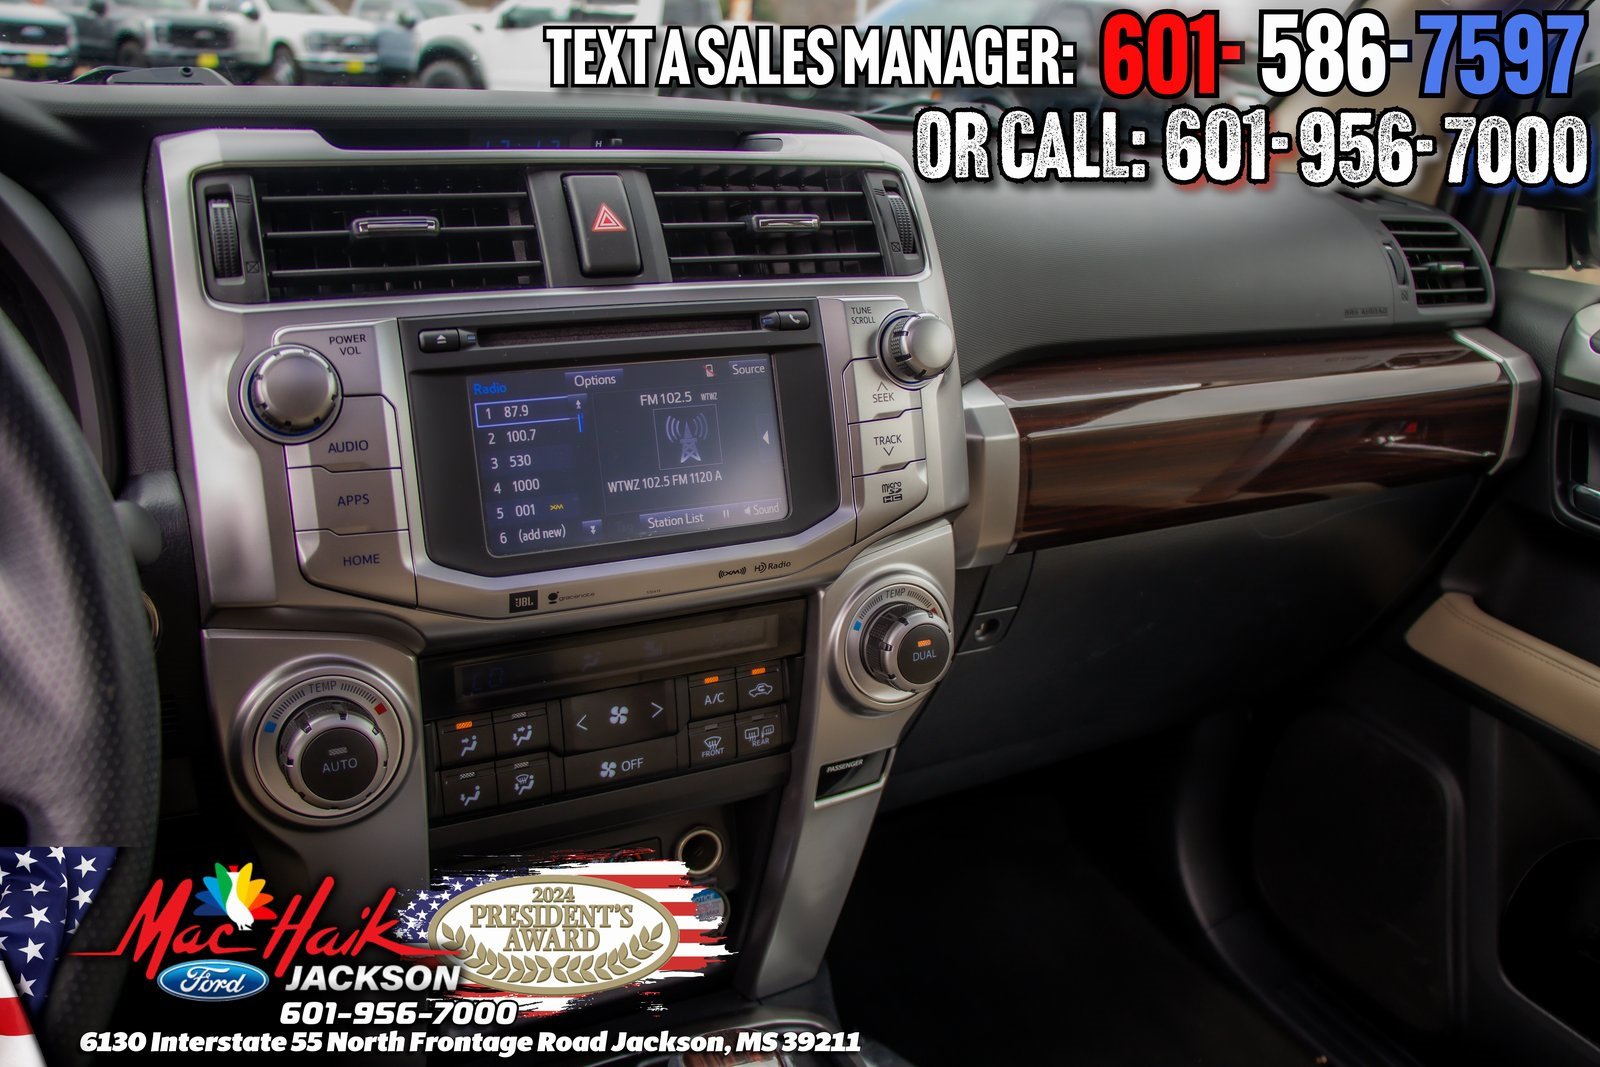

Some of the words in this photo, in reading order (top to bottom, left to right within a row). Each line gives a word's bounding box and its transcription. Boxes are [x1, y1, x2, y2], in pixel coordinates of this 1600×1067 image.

[851, 306, 872, 315] TUNE
[851, 316, 876, 325] SCROLL
[329, 334, 367, 345] POWER
[339, 346, 361, 356] VOL
[732, 363, 766, 376] Source
[574, 374, 616, 387] Options
[473, 383, 507, 394] Radio
[640, 393, 658, 406] FM
[660, 391, 693, 405] 102.5
[701, 391, 718, 401] WTWZ
[872, 392, 895, 404] SEEK
[485, 408, 492, 420] 1
[504, 405, 529, 418] 87.9
[488, 432, 496, 445] 2
[506, 429, 537, 443] 100.7
[874, 434, 902, 446] TRACK
[328, 439, 369, 454] AUDIO
[490, 457, 499, 469] 3
[509, 454, 532, 467] 530
[494, 482, 502, 495] 4
[512, 479, 540, 492] 1000
[608, 478, 640, 494] WTWZ
[642, 475, 671, 490] 102.5
[672, 473, 688, 486] FM
[690, 471, 712, 484] 1120
[714, 470, 722, 482] A
[337, 493, 370, 507] APPS
[496, 507, 504, 520] 5
[515, 504, 536, 518] 001
[753, 503, 779, 516] Sound
[647, 514, 683, 529] Station
[684, 512, 704, 526] List
[499, 531, 508, 544] 6
[518, 527, 540, 544] (add
[542, 523, 567, 539] new)
[343, 553, 380, 567] HOME
[768, 560, 792, 571] Radio
[886, 588, 906, 599] TEMP
[515, 596, 534, 607] JBL
[912, 649, 937, 662] DUAL
[308, 680, 337, 694] TEMP
[704, 691, 725, 706] A/C
[752, 736, 770, 748] REAR
[701, 747, 725, 759] FRONT
[322, 758, 358, 774] AUTO
[621, 757, 644, 773] OFF
[826, 758, 864, 774] PASSENGER
